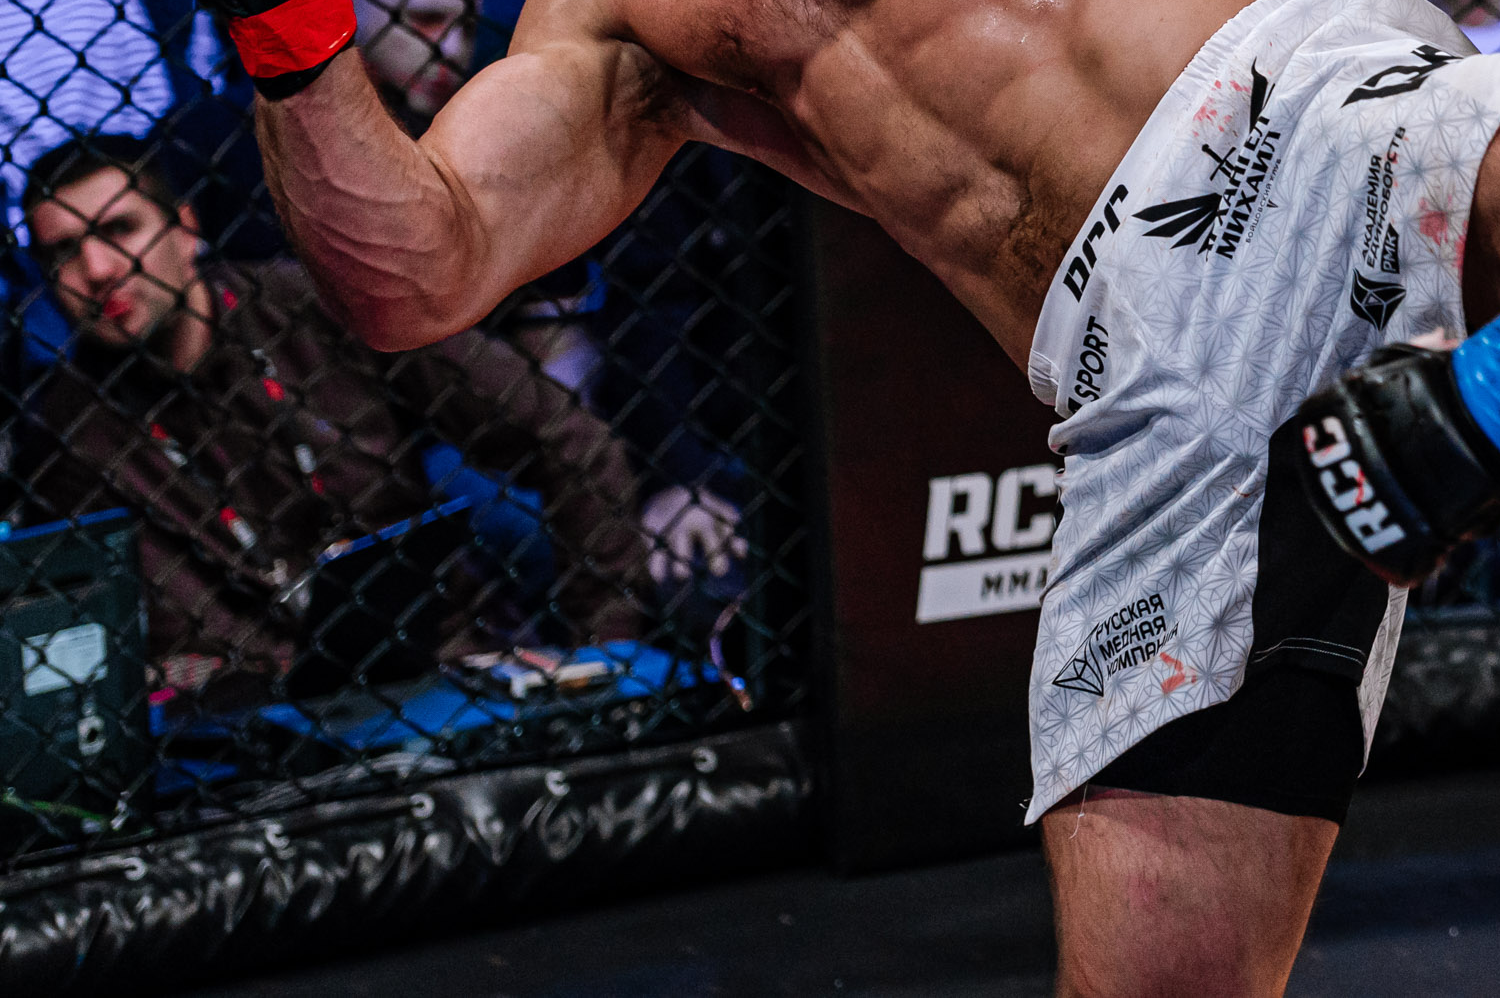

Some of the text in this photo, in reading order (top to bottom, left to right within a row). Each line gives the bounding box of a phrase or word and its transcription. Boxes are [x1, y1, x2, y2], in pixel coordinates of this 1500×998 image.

[1215, 130, 1282, 260] МИХАИЛ
[1361, 154, 1383, 261] АКАДЕМИЯ
[1366, 126, 1407, 269] ЕДИНОБОРСТВ
[1382, 233, 1398, 273] РМК
[1074, 315, 1109, 405] SPORT
[1303, 415, 1407, 554] RCC
[1095, 593, 1165, 642] РУССКАЯ
[1098, 615, 1167, 661] МЕДНАЯ
